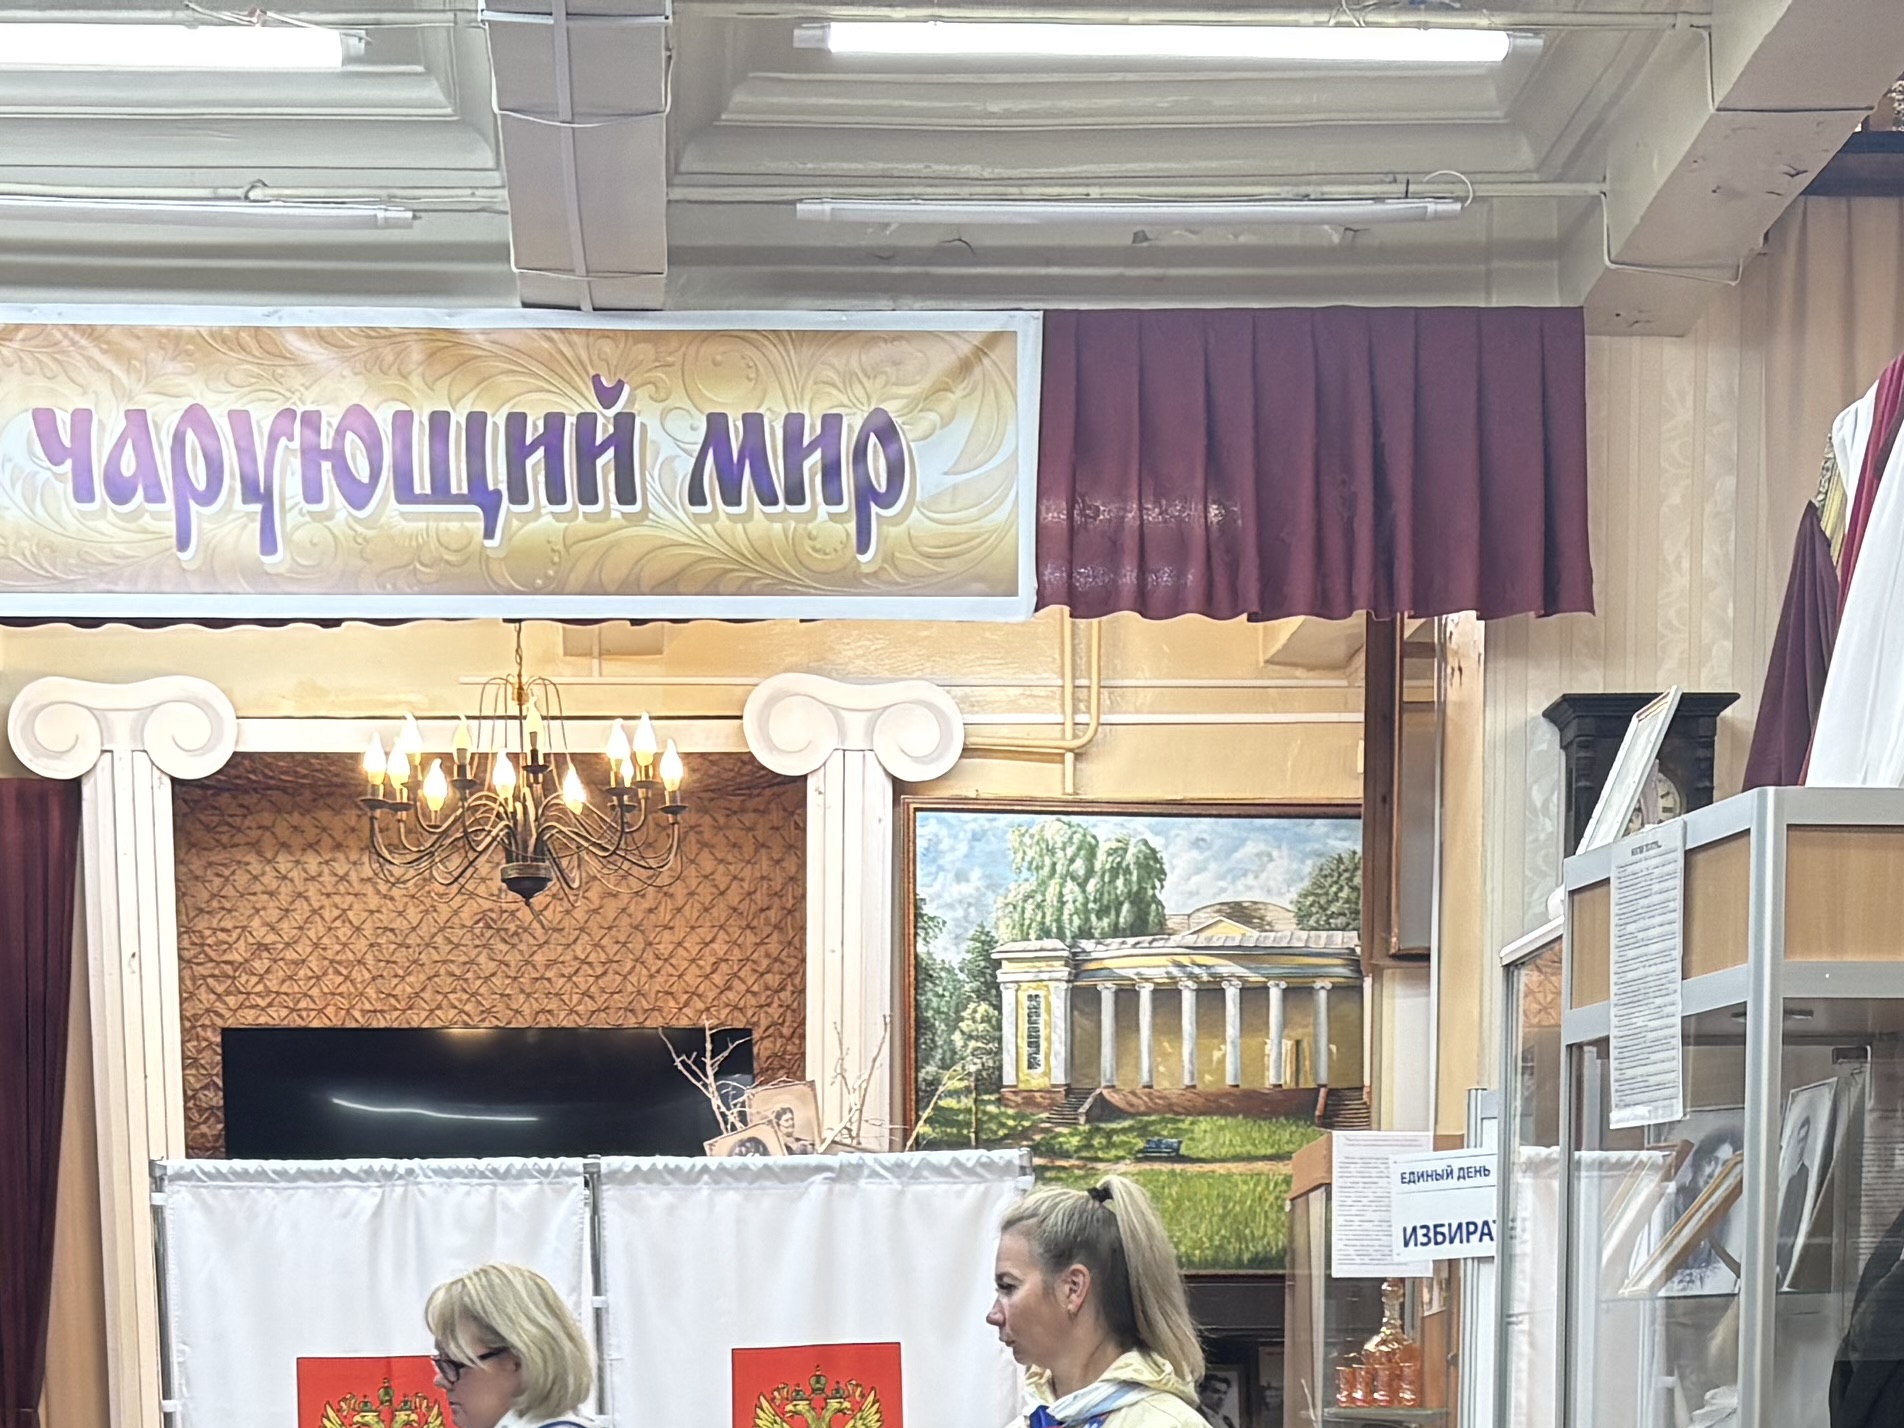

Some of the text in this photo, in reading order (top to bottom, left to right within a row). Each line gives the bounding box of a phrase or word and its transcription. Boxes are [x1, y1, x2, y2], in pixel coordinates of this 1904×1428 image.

[30, 374, 644, 561] чарующий
[684, 402, 918, 559] мир
[1400, 1164, 1491, 1185] ЕДИНЫЙ ДЕНЬ
